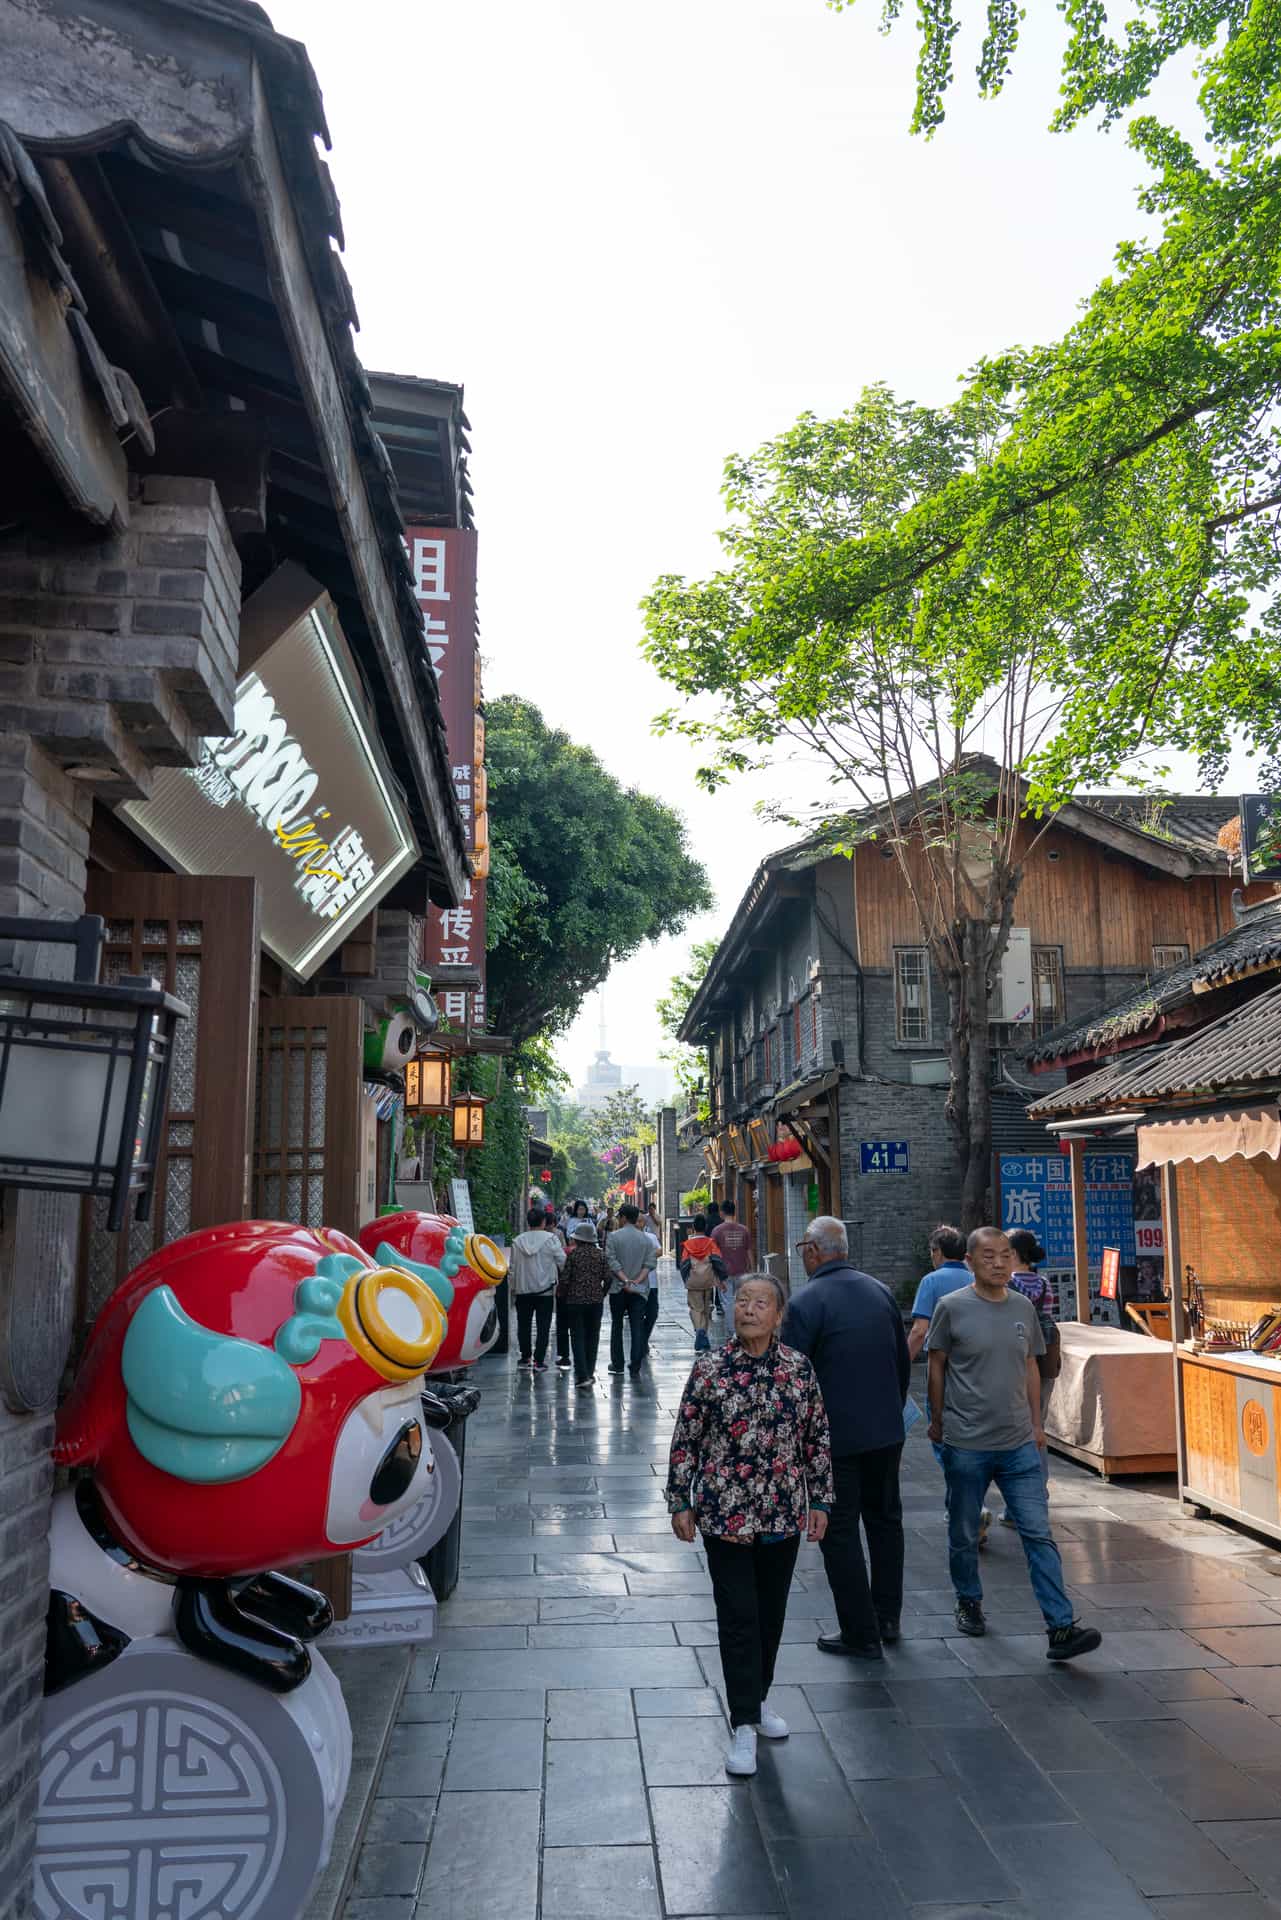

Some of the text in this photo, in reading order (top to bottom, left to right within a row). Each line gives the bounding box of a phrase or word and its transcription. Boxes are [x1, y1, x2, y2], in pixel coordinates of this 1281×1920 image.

[871, 1151, 889, 1167] 41
[1025, 1157, 1130, 1183] 中国行社
